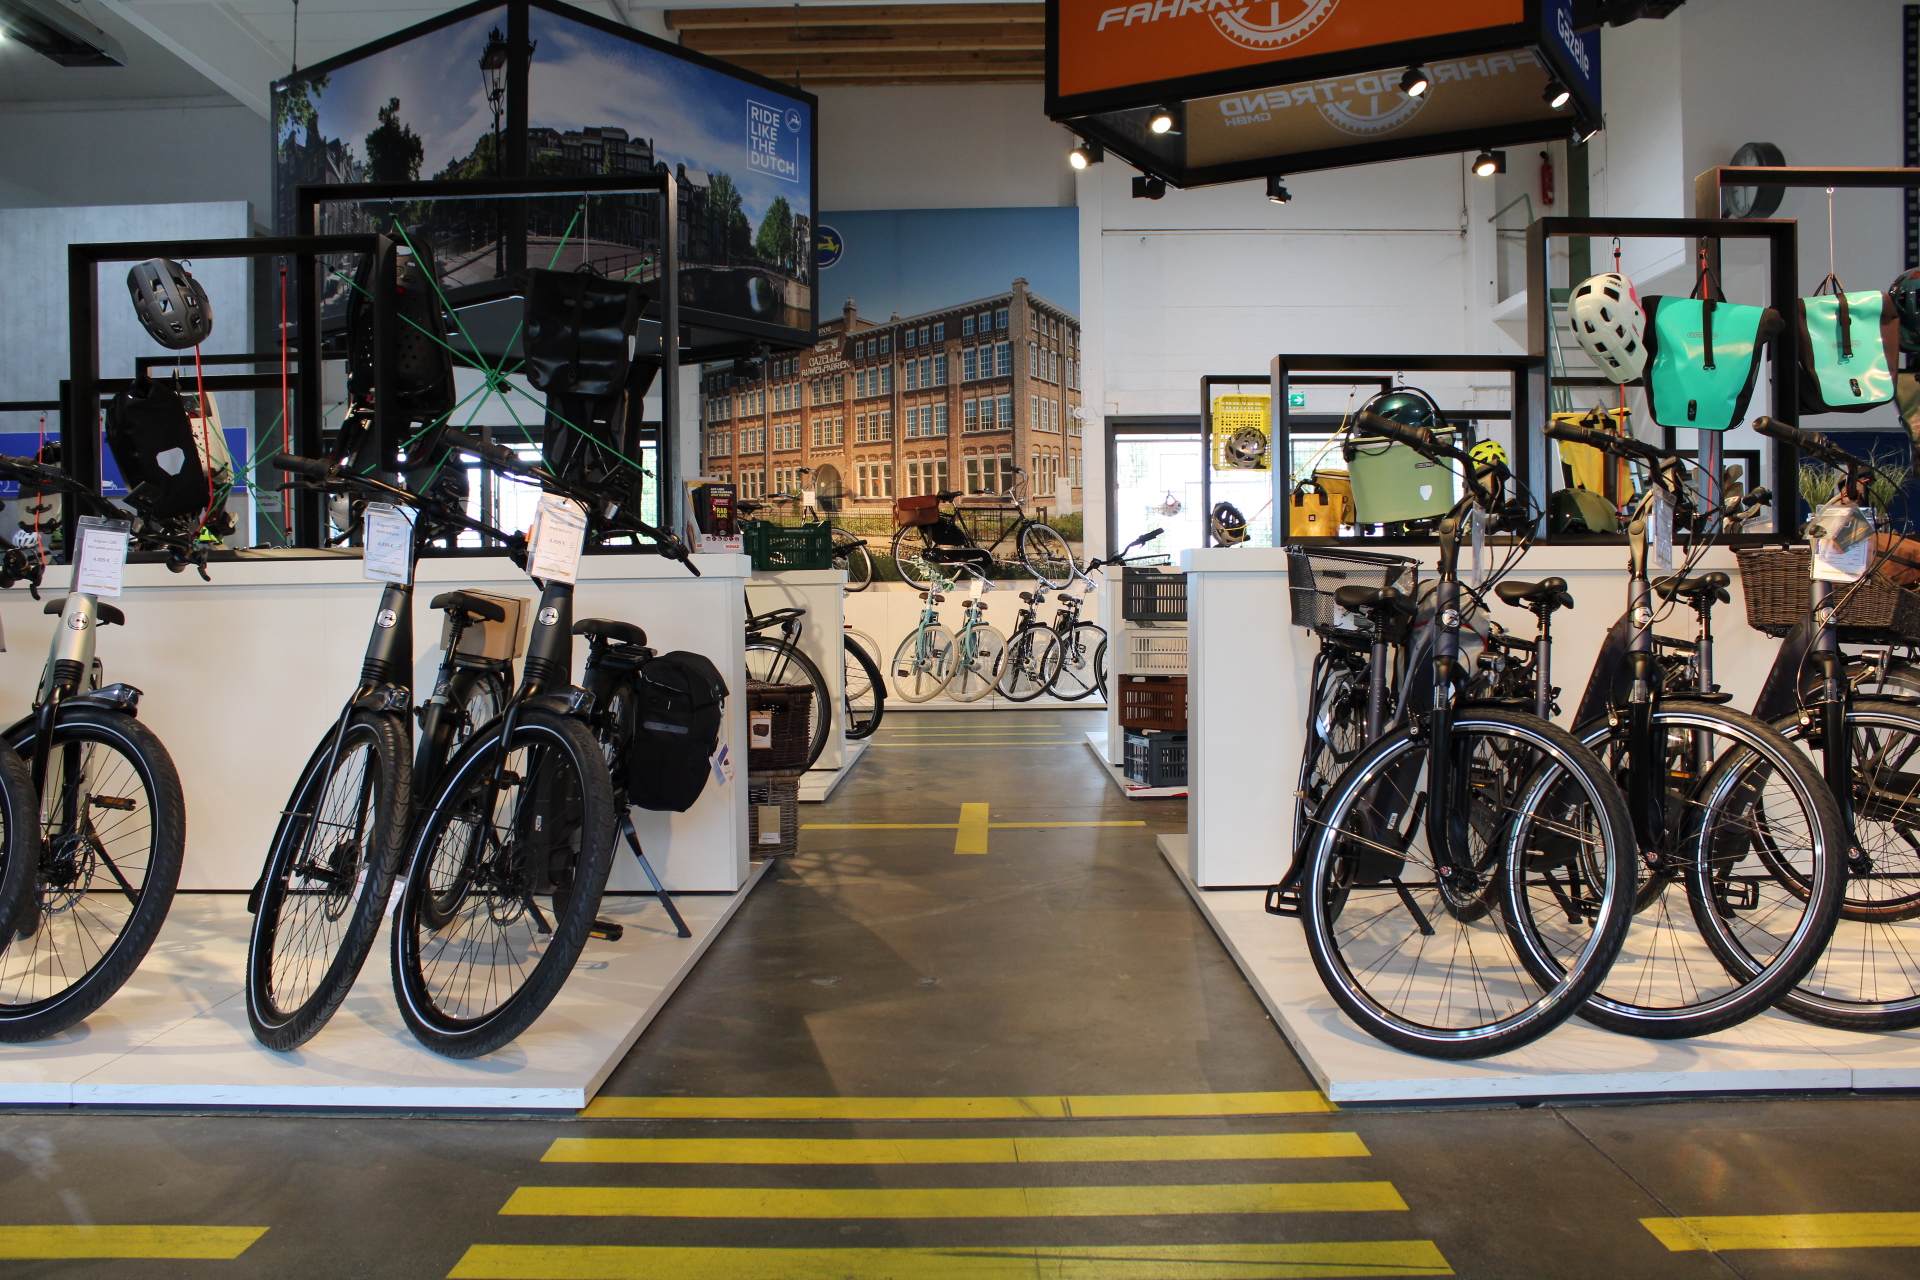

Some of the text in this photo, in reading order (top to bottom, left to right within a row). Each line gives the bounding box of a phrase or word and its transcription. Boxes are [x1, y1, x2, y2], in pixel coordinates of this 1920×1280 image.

[1097, 0, 1263, 31] FAHR
[1557, 7, 1589, 80] Gazelle
[751, 106, 780, 128] RIDE
[751, 121, 778, 142] LIKE
[751, 135, 776, 156] THE
[751, 151, 795, 176] DUTCH
[809, 352, 842, 368] GAZELLE
